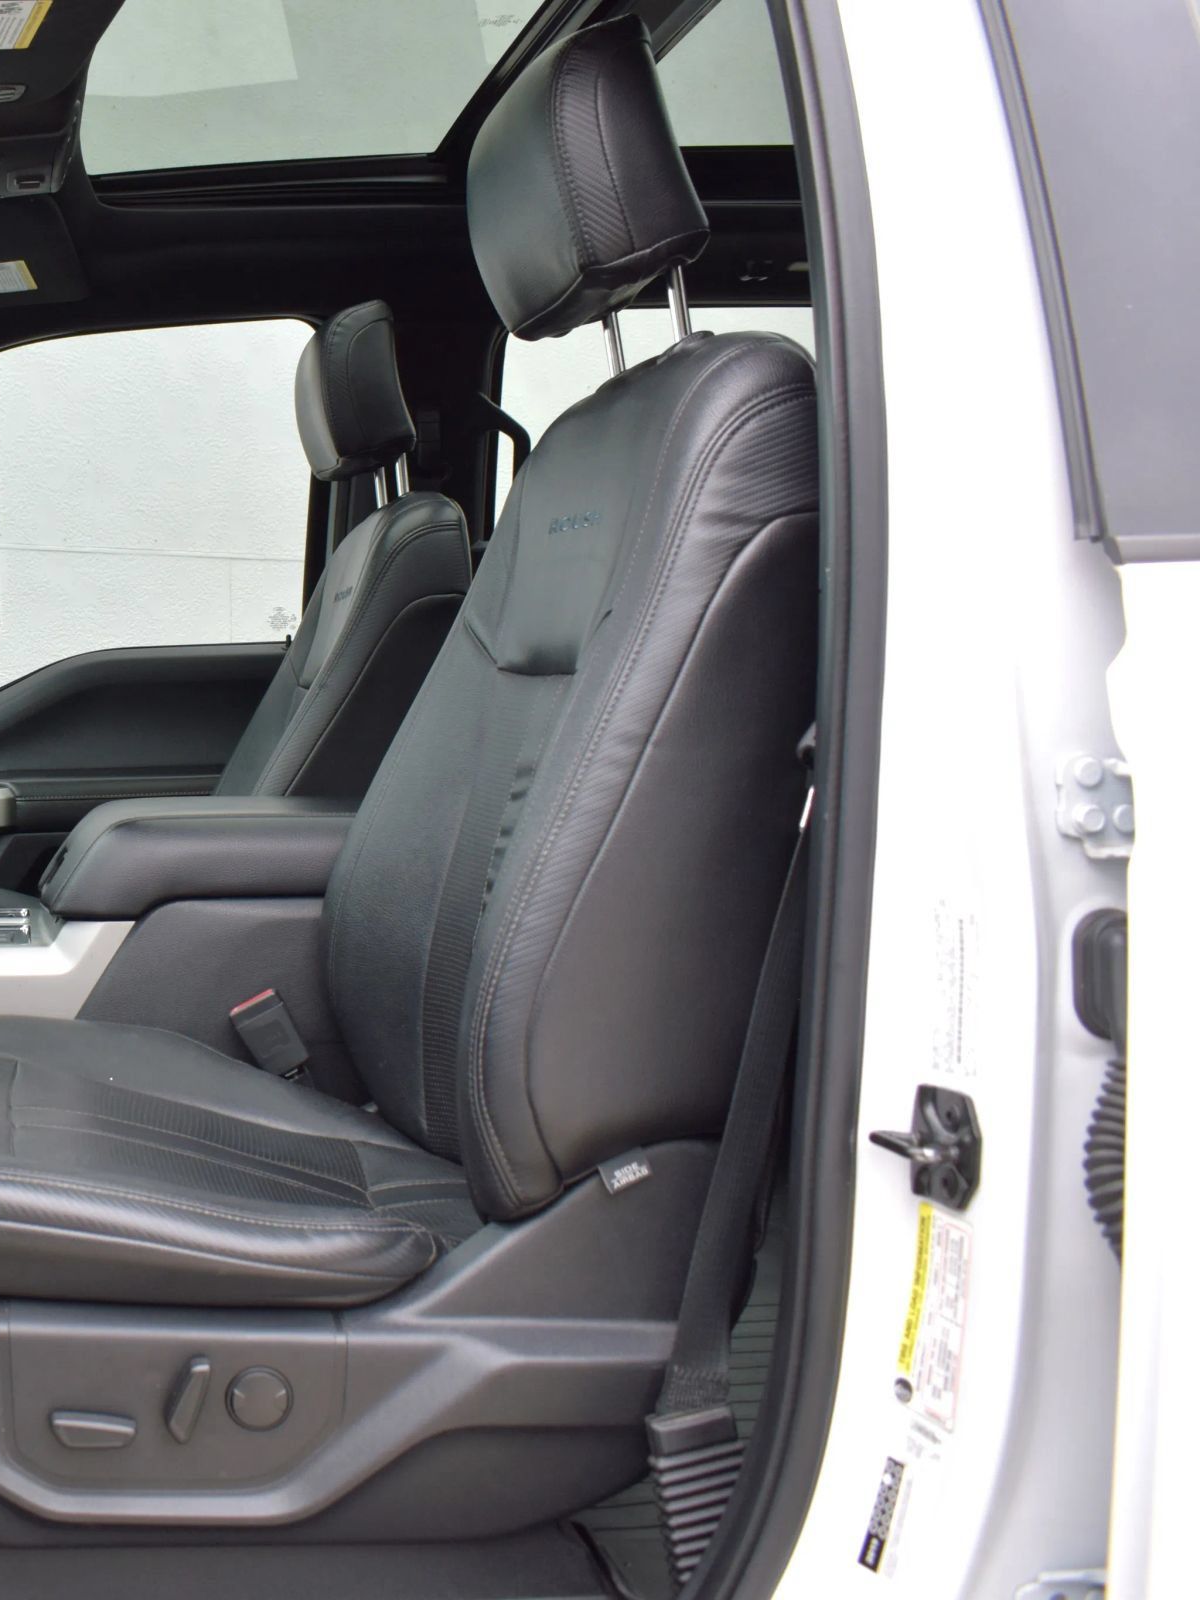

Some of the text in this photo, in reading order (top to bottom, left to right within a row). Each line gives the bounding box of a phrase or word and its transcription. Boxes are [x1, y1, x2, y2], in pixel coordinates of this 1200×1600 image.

[610, 1164, 649, 1189] AIRBAG
[614, 1161, 638, 1178] SIDE
[914, 1215, 926, 1286] INFORMATION
